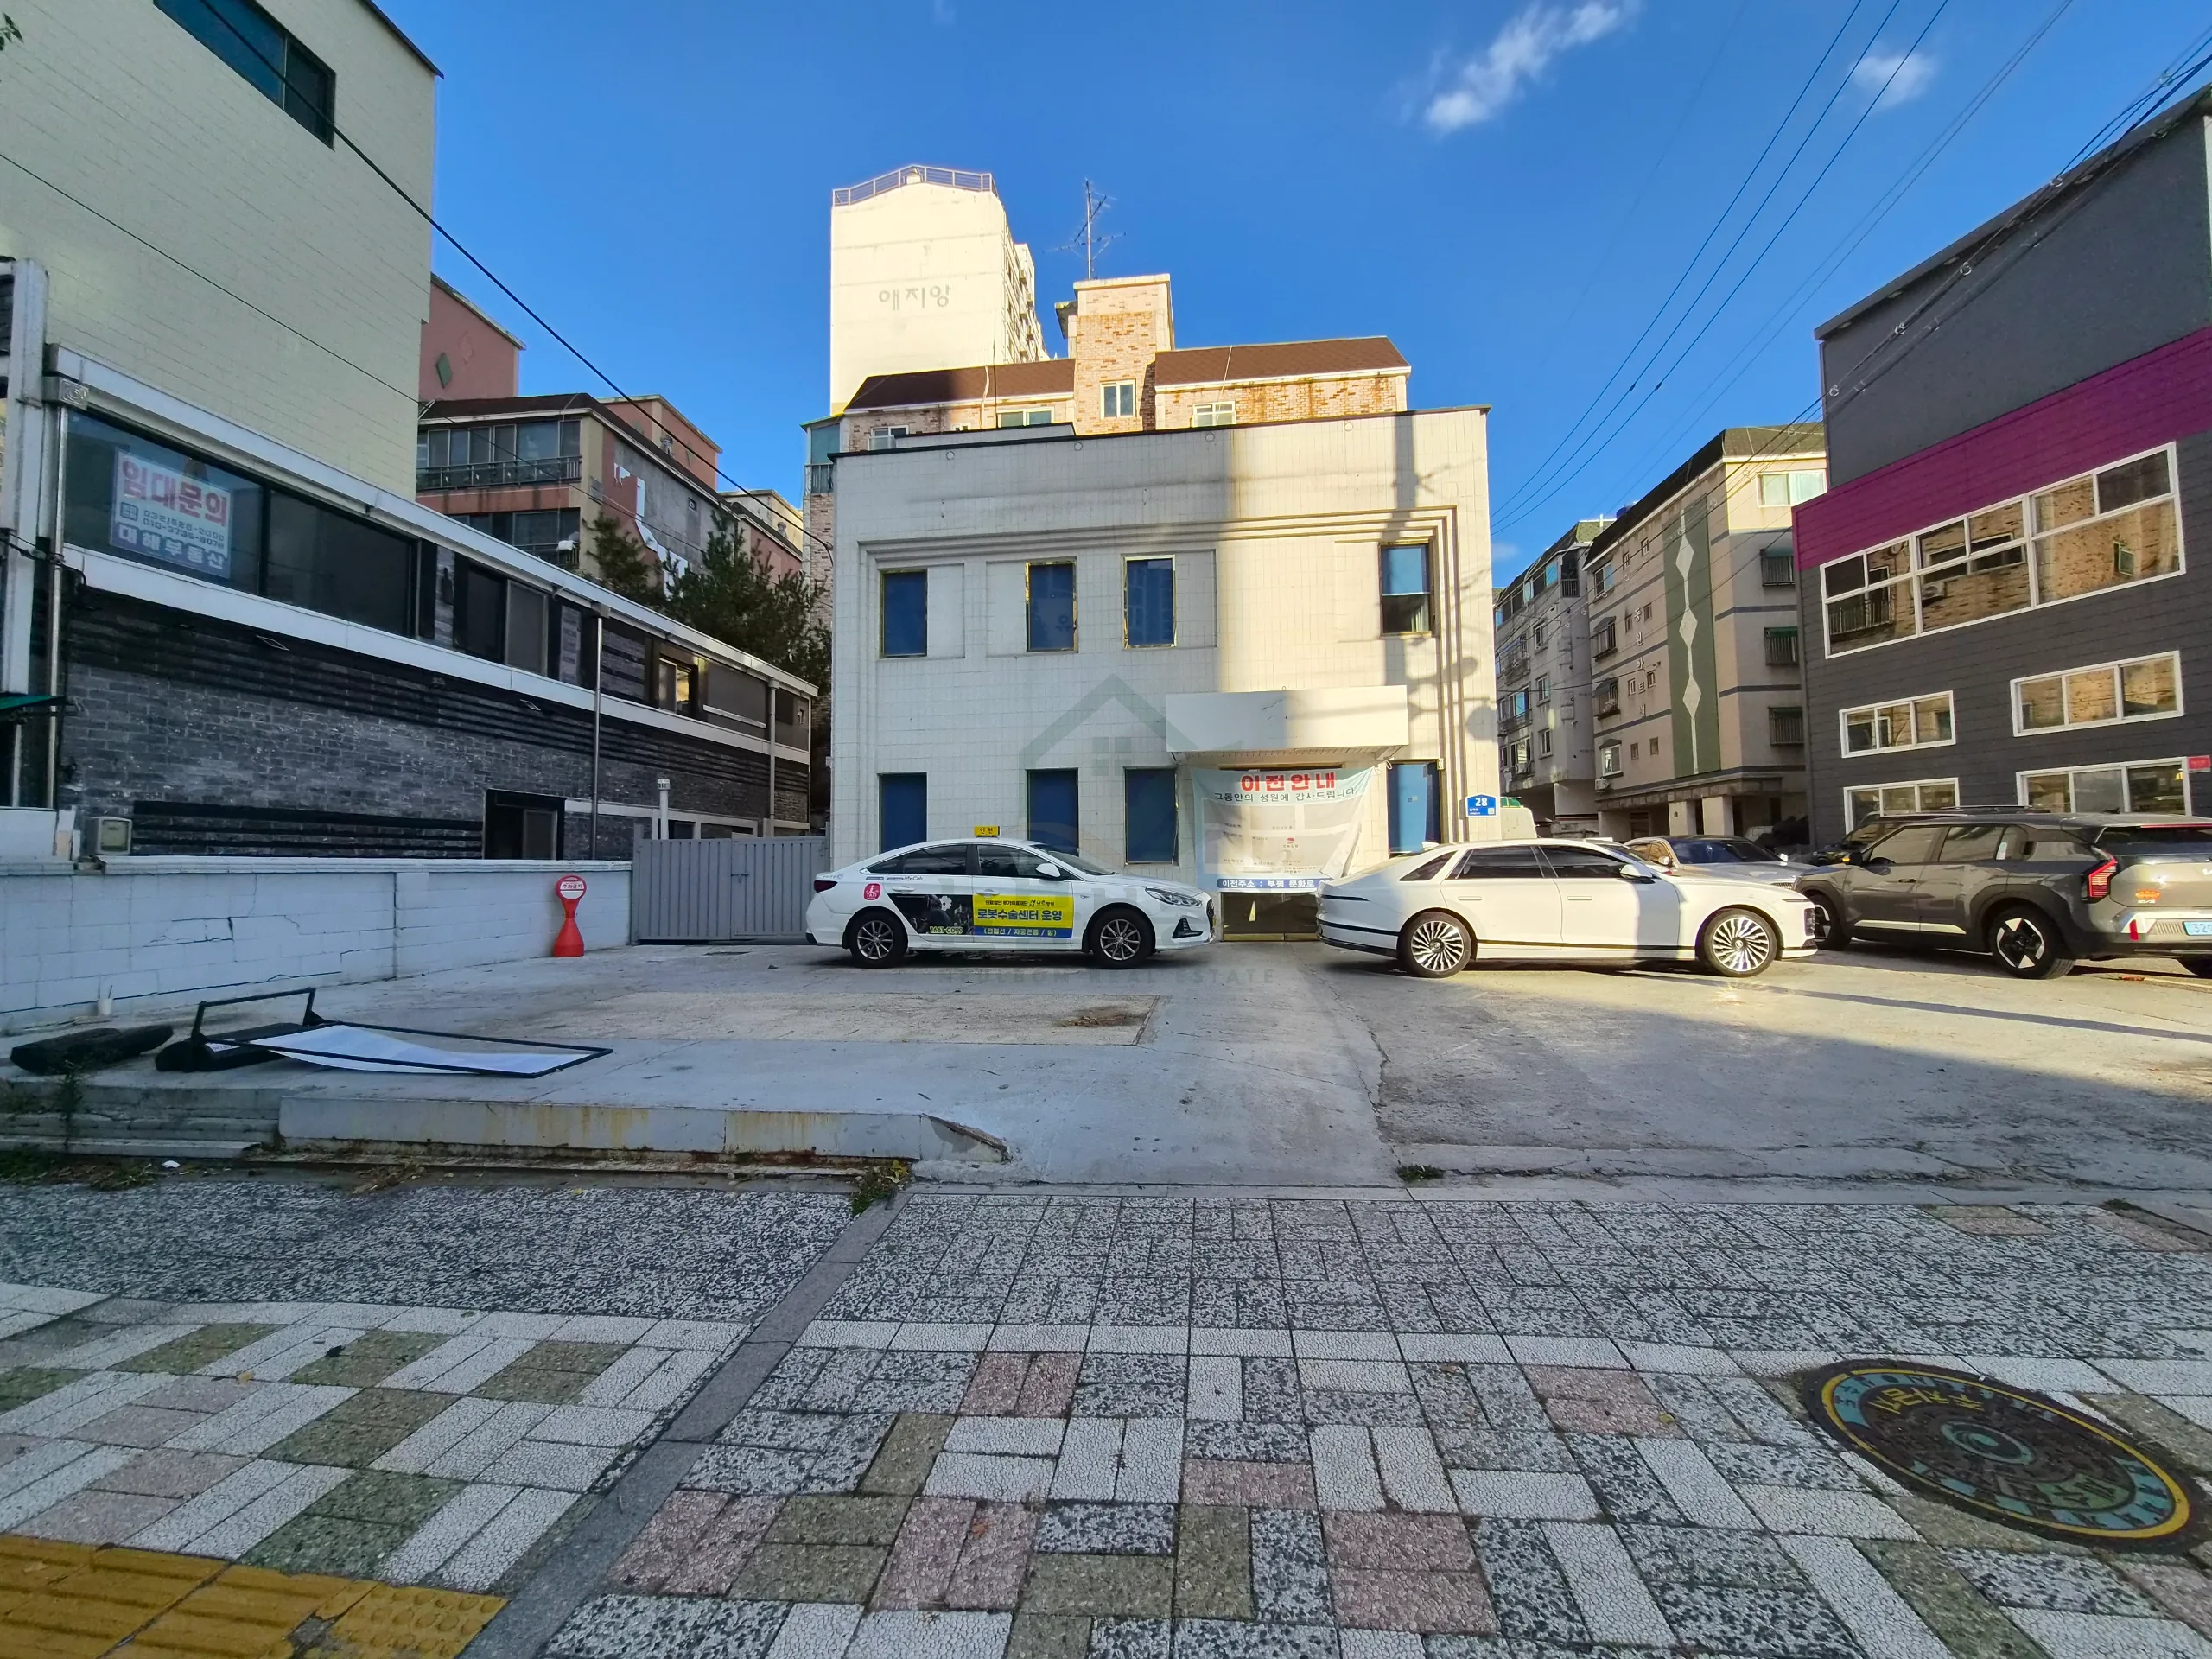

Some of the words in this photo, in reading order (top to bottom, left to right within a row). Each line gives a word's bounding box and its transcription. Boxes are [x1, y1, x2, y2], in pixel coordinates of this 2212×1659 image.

[879, 285, 951, 311] 애지앙
[123, 461, 227, 527] 임대문의
[1241, 772, 1336, 792] 이전안내
[1214, 792, 1254, 803] 그동안의
[1259, 793, 1289, 803] 성원에
[1475, 797, 1488, 807] 28
[1222, 880, 1255, 888] 이전주소
[1267, 880, 1285, 888] 부평
[1288, 880, 1315, 888] 문화로
[977, 908, 1039, 921] 로봇수술센터
[1041, 909, 1063, 921] 운영
[1866, 1387, 1986, 1414] 주차금지
